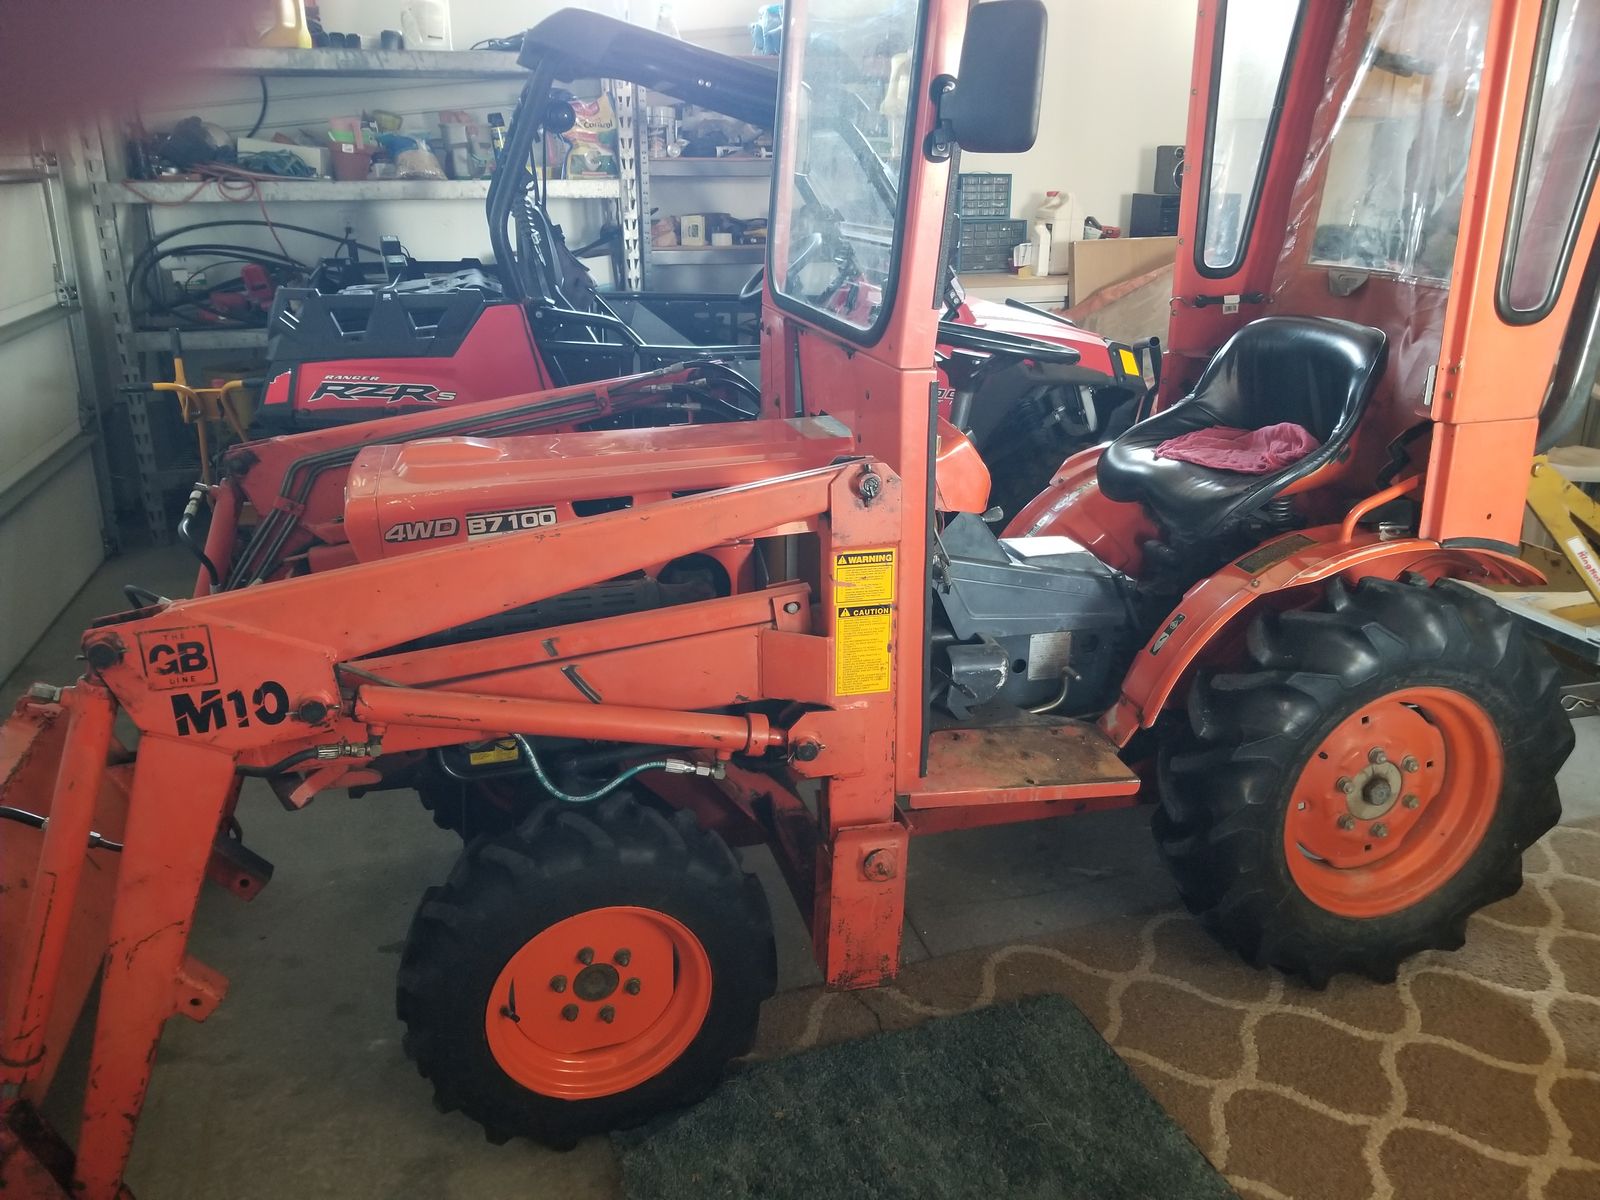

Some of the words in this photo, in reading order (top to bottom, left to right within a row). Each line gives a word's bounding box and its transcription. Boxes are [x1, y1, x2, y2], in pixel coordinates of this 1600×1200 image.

[308, 381, 439, 404] RZR
[385, 518, 459, 542] 4WD
[467, 510, 557, 536] B7100
[848, 554, 892, 563] WARNING
[853, 607, 889, 616] CAUTION
[149, 642, 208, 675] GB
[171, 681, 289, 736] M10
